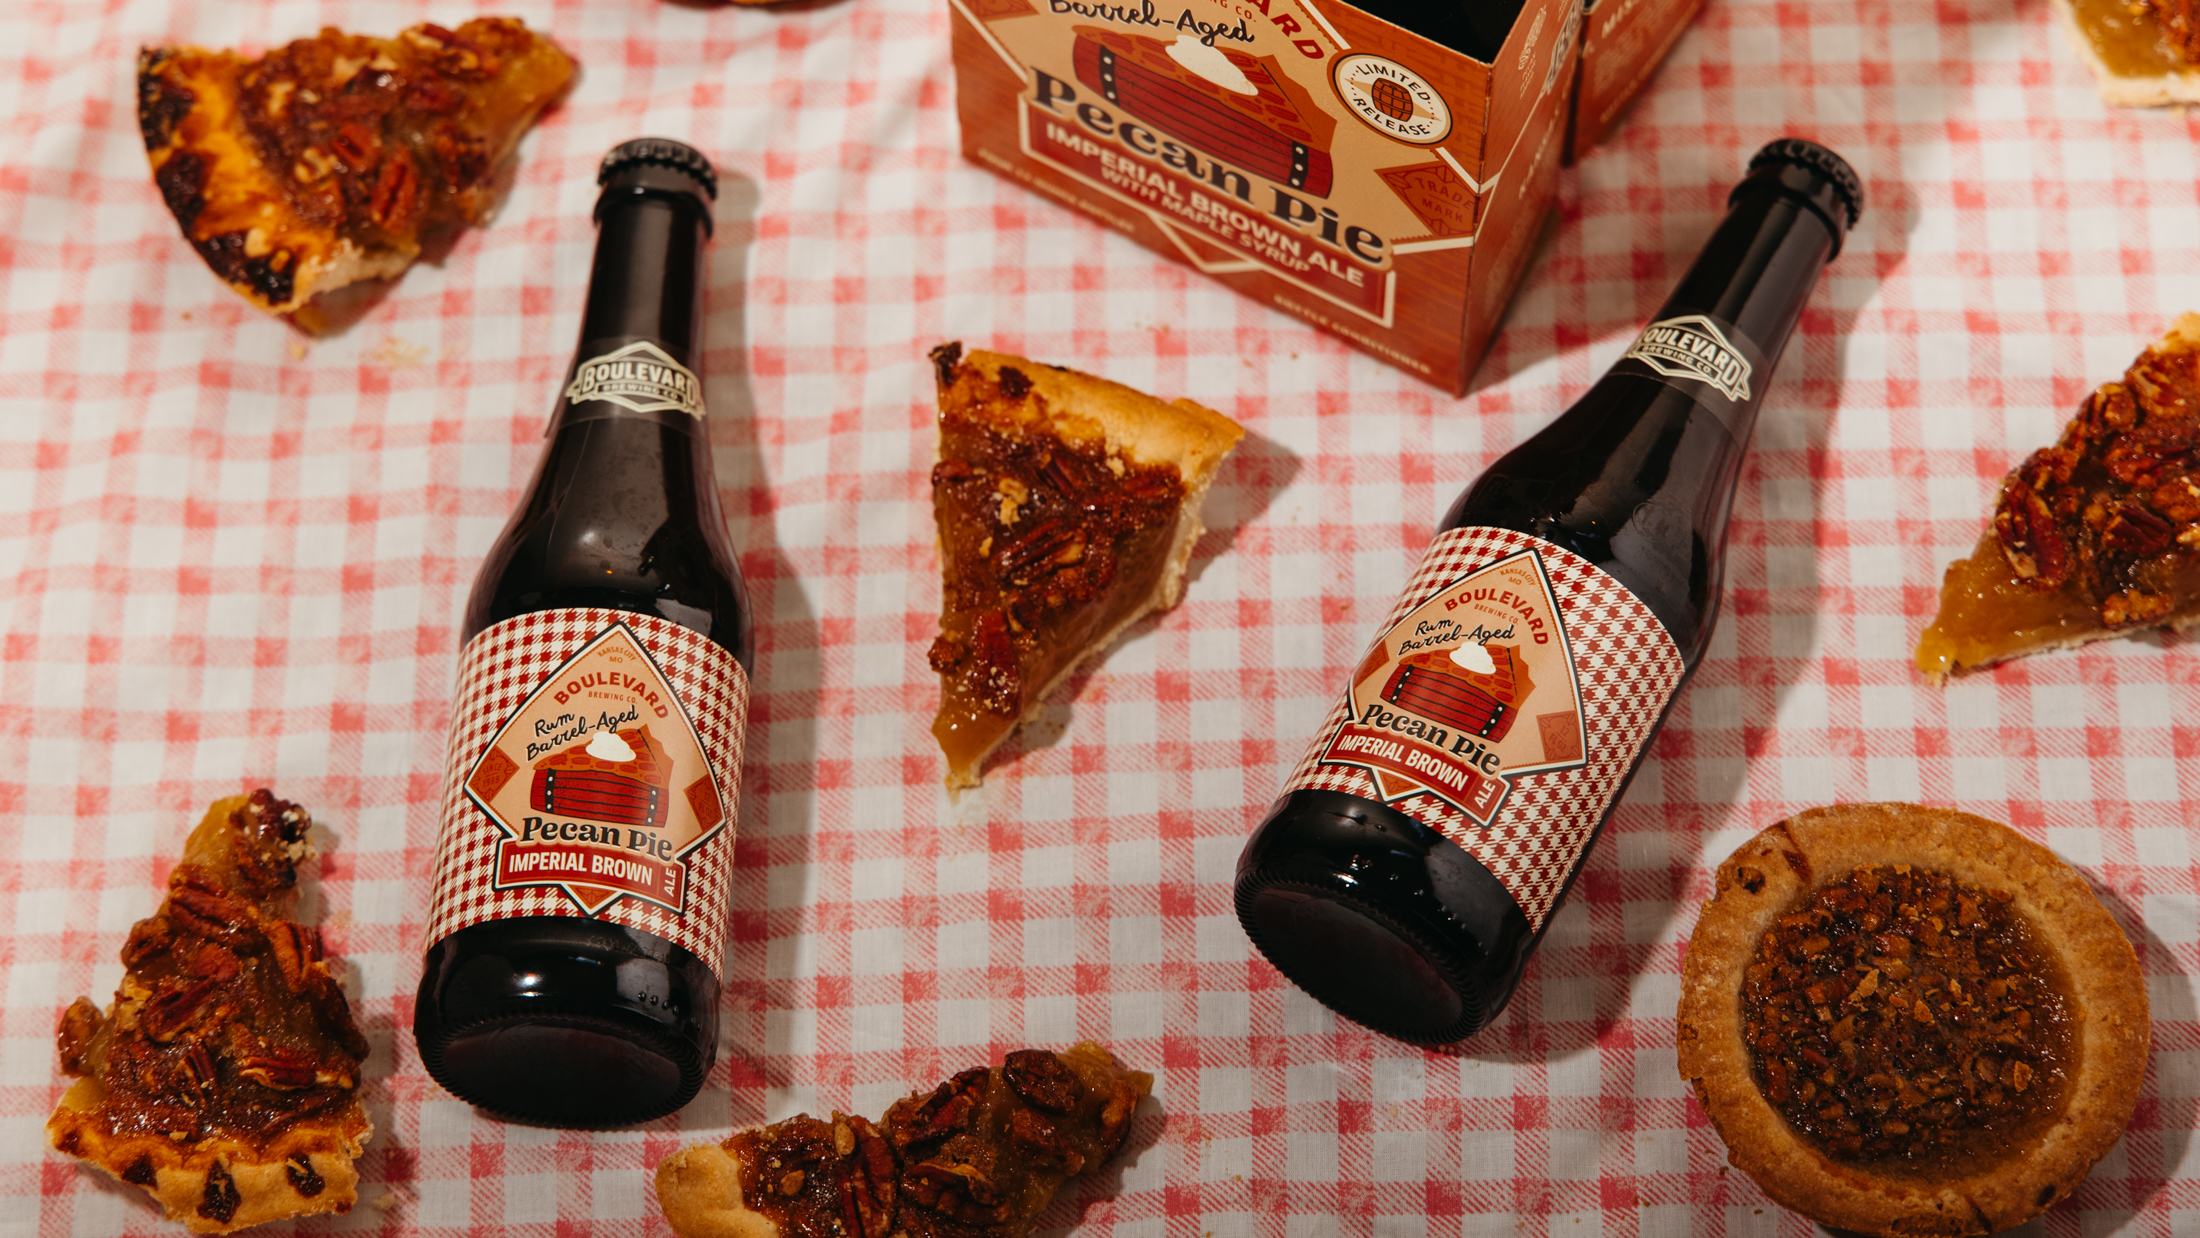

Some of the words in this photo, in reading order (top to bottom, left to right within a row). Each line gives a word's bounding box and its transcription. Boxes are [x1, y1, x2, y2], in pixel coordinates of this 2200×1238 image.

[1356, 63, 1431, 101] LIMITED
[1352, 97, 1431, 136] RELEASE
[1030, 66, 1255, 207] Pecan
[1046, 122, 1184, 200] IMPERIAL
[1190, 190, 1301, 258] BROWN
[1308, 250, 1364, 288] ALE
[1415, 177, 1475, 210] TRADE
[1101, 165, 1158, 202] WITH
[1162, 192, 1234, 240] MAPLE
[1238, 232, 1311, 272] SYRUP
[1422, 198, 1463, 223] MARK
[1641, 345, 1694, 364] BREWING
[581, 361, 698, 406] BOULEVARD
[602, 383, 660, 396] BREWING
[1500, 568, 1526, 577] KANSAS
[1524, 574, 1536, 586] CITY
[1508, 576, 1522, 585] MO
[1414, 618, 1454, 637] Rum
[1444, 588, 1549, 645] BOULEVARD
[1474, 603, 1508, 620] BREWING
[1508, 615, 1519, 626] CO.
[597, 646, 624, 657] KANSAS
[623, 650, 637, 661] CITY
[1397, 624, 1516, 657] Barrel-Aged
[609, 656, 623, 664] MO
[553, 671, 669, 720] BOULEVARD
[588, 690, 625, 702] BREWING
[626, 695, 638, 704] CO.
[526, 704, 640, 761] Barrel-Aged
[534, 710, 576, 738] Rum
[1560, 725, 1570, 738] 12
[1357, 704, 1448, 748] Pecan
[1449, 734, 1501, 776] Pie
[483, 762, 503, 775] SINCE
[1337, 735, 1405, 763] IMPERIAL
[1404, 749, 1469, 791] BROWN
[483, 775, 500, 788] 1989
[1473, 780, 1496, 809] ALE
[520, 816, 621, 847] Pecan
[626, 828, 673, 862] Pie
[508, 852, 588, 873] IMPERIAL
[591, 855, 653, 886] BROWN
[663, 868, 677, 897] ALE
